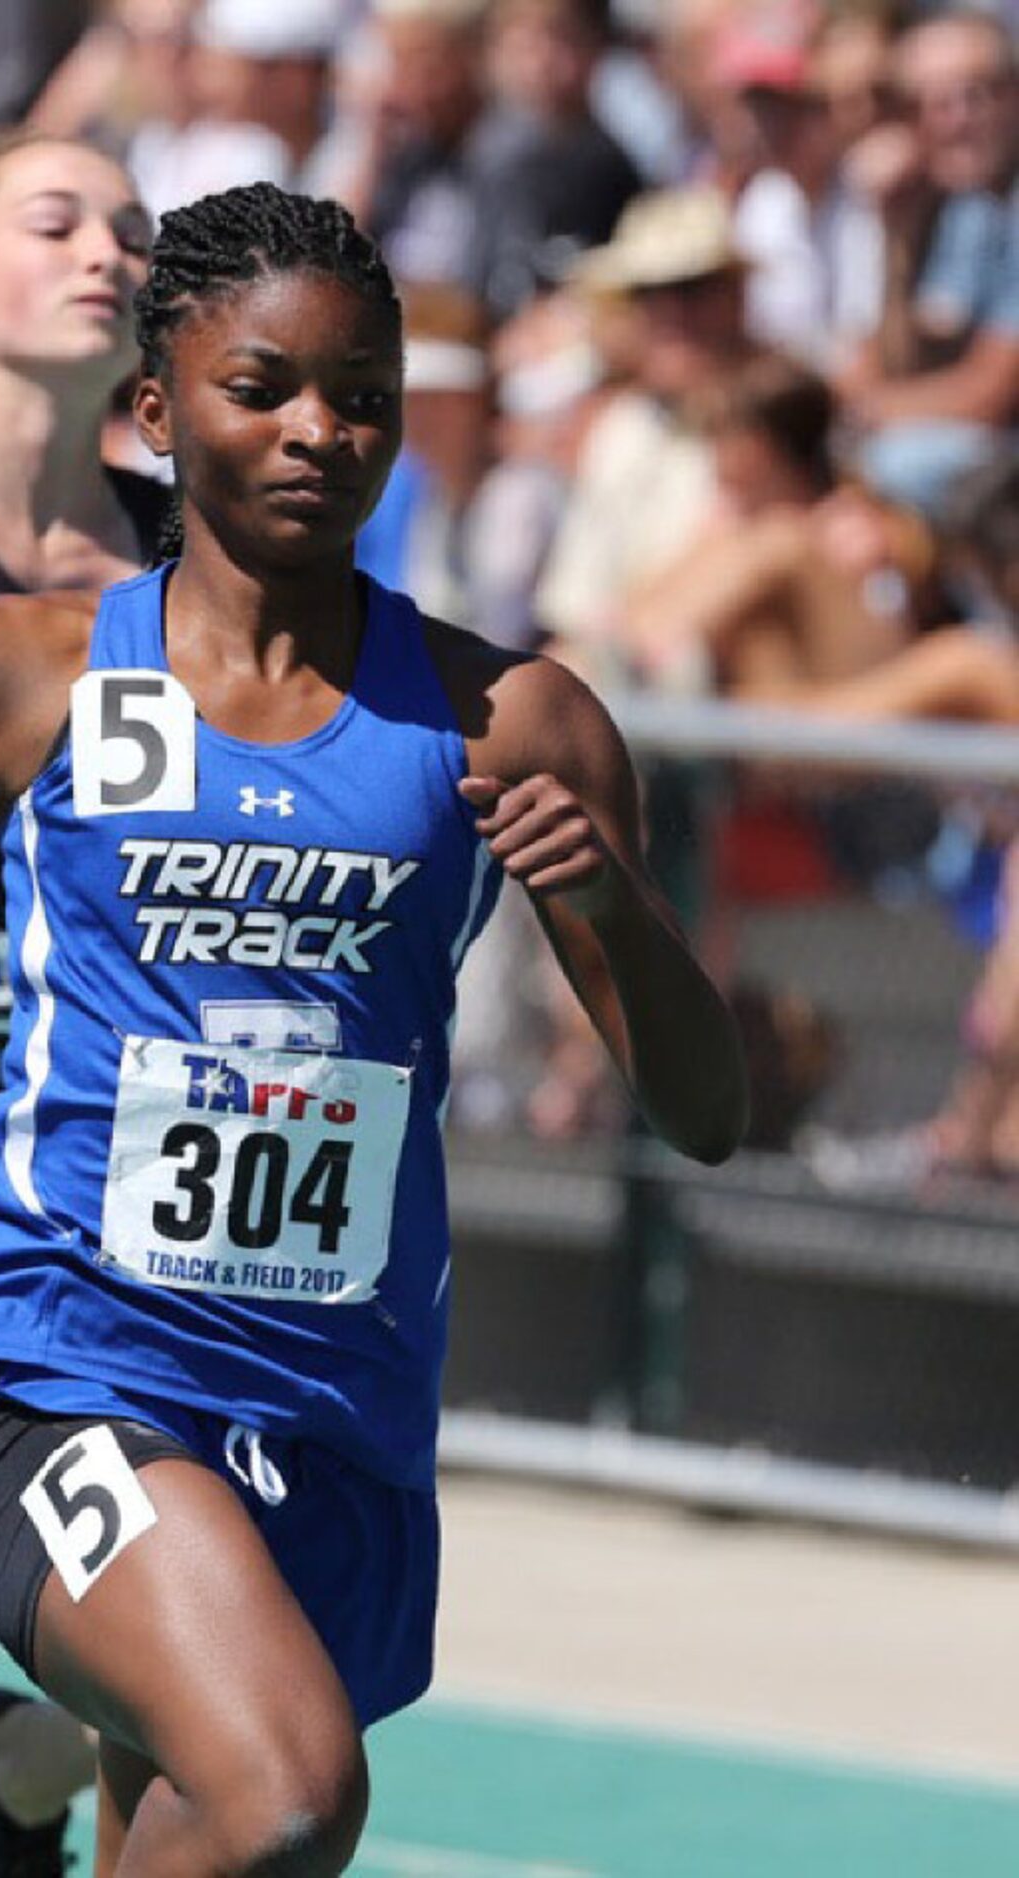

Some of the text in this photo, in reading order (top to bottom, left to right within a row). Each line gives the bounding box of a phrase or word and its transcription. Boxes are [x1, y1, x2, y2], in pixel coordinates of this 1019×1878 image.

[99, 677, 167, 806] 5
[118, 838, 420, 911] TRINITY
[135, 905, 392, 973] TRACK
[152, 1121, 355, 1256] 304
[146, 1250, 347, 1293] TRACK & FIELD 2017
[40, 1441, 122, 1576] 5
